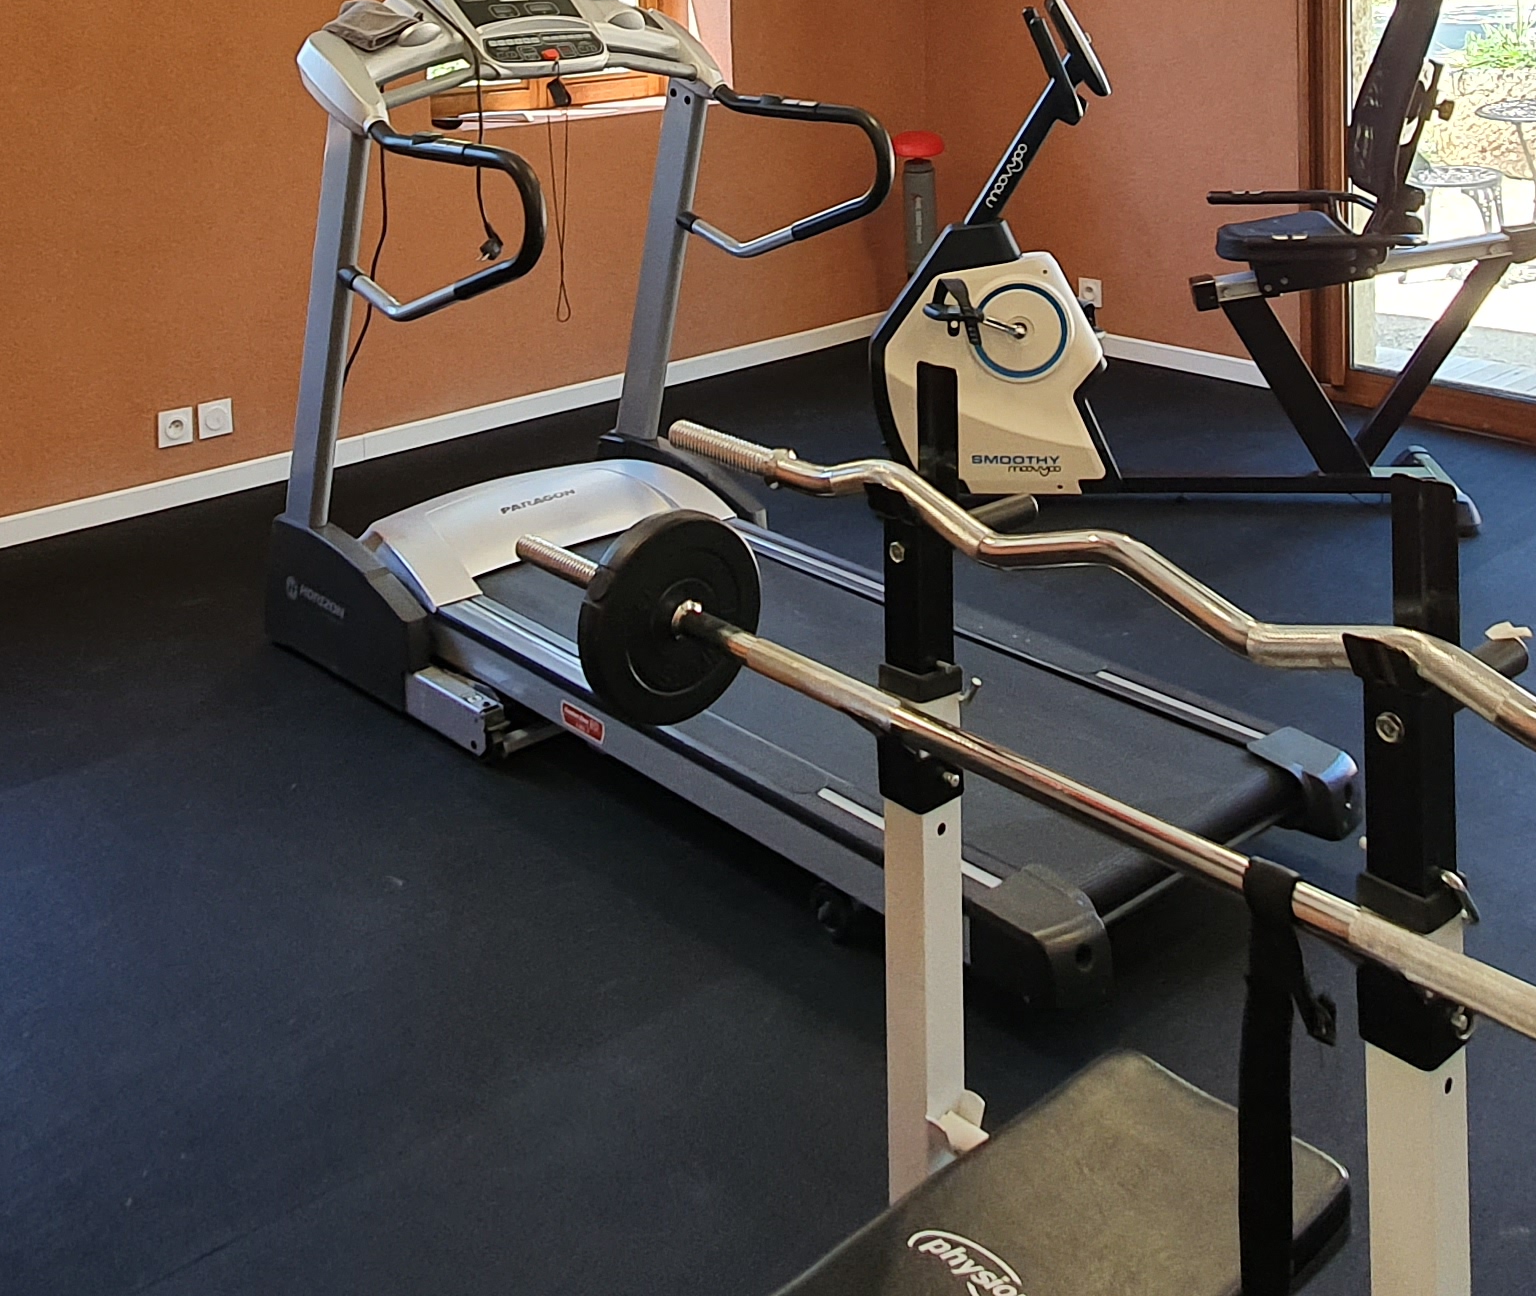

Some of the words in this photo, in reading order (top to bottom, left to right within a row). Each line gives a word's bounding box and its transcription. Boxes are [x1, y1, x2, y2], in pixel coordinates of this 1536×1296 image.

[986, 143, 1028, 208] moovyoo
[971, 455, 1060, 465] SMOOTHY
[1008, 465, 1062, 477] moovyoo
[500, 489, 576, 515] PARAGON
[300, 584, 345, 619] HORIZON
